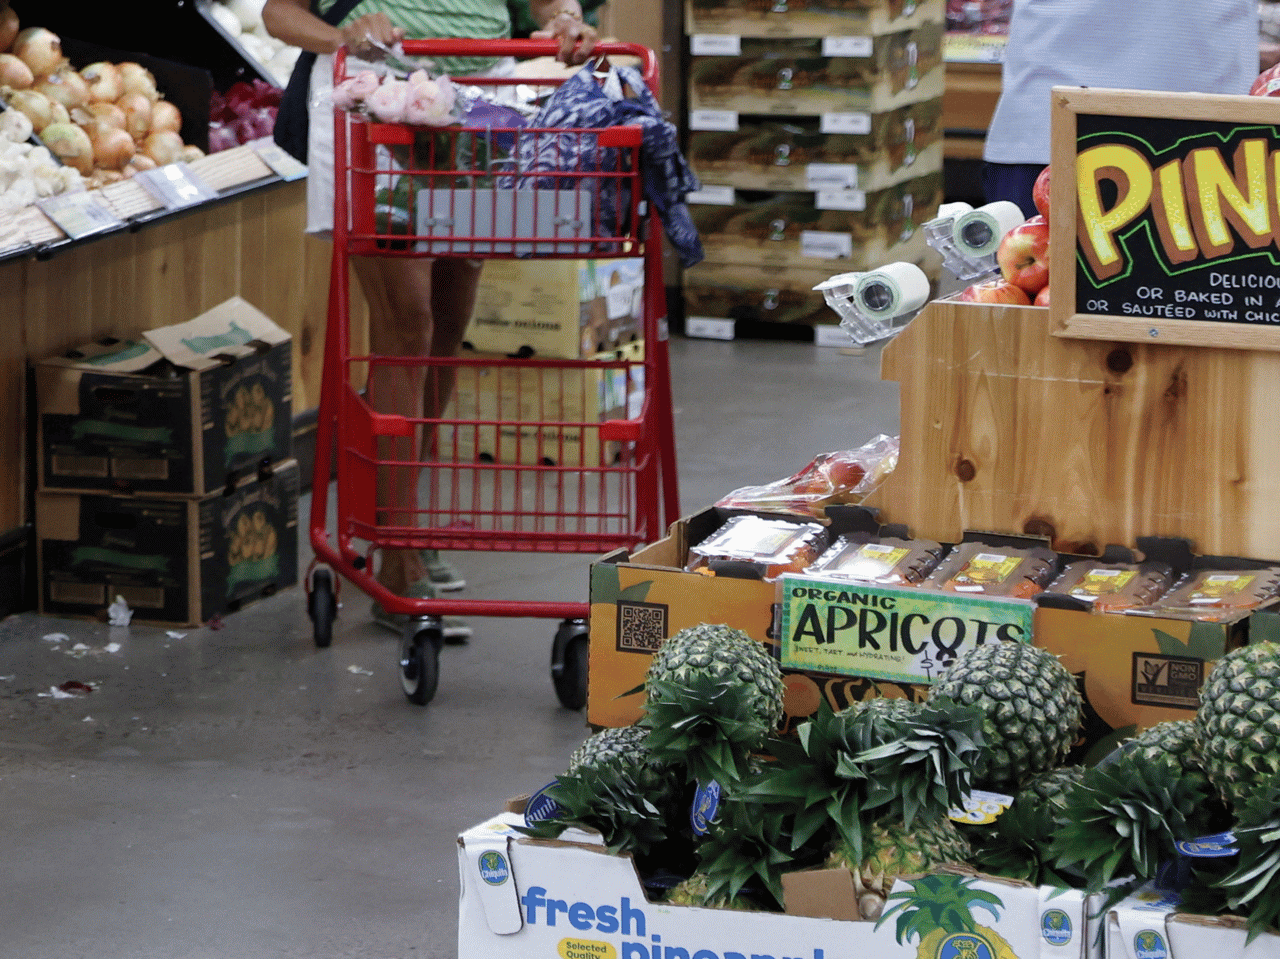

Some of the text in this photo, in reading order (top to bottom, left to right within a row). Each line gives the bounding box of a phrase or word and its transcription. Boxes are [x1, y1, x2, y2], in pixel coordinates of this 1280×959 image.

[1076, 138, 1280, 281] PIN
[1136, 286, 1264, 307] OR BAKED IN
[1086, 299, 1109, 312] OR
[1121, 303, 1196, 319] SAUTÉED
[791, 587, 897, 610] ORGANIC
[1170, 663, 1196, 673] NON
[1170, 670, 1197, 681] GMO
[481, 869, 509, 880] Chiquita
[521, 886, 647, 938] fresh
[566, 941, 607, 955] Selected
